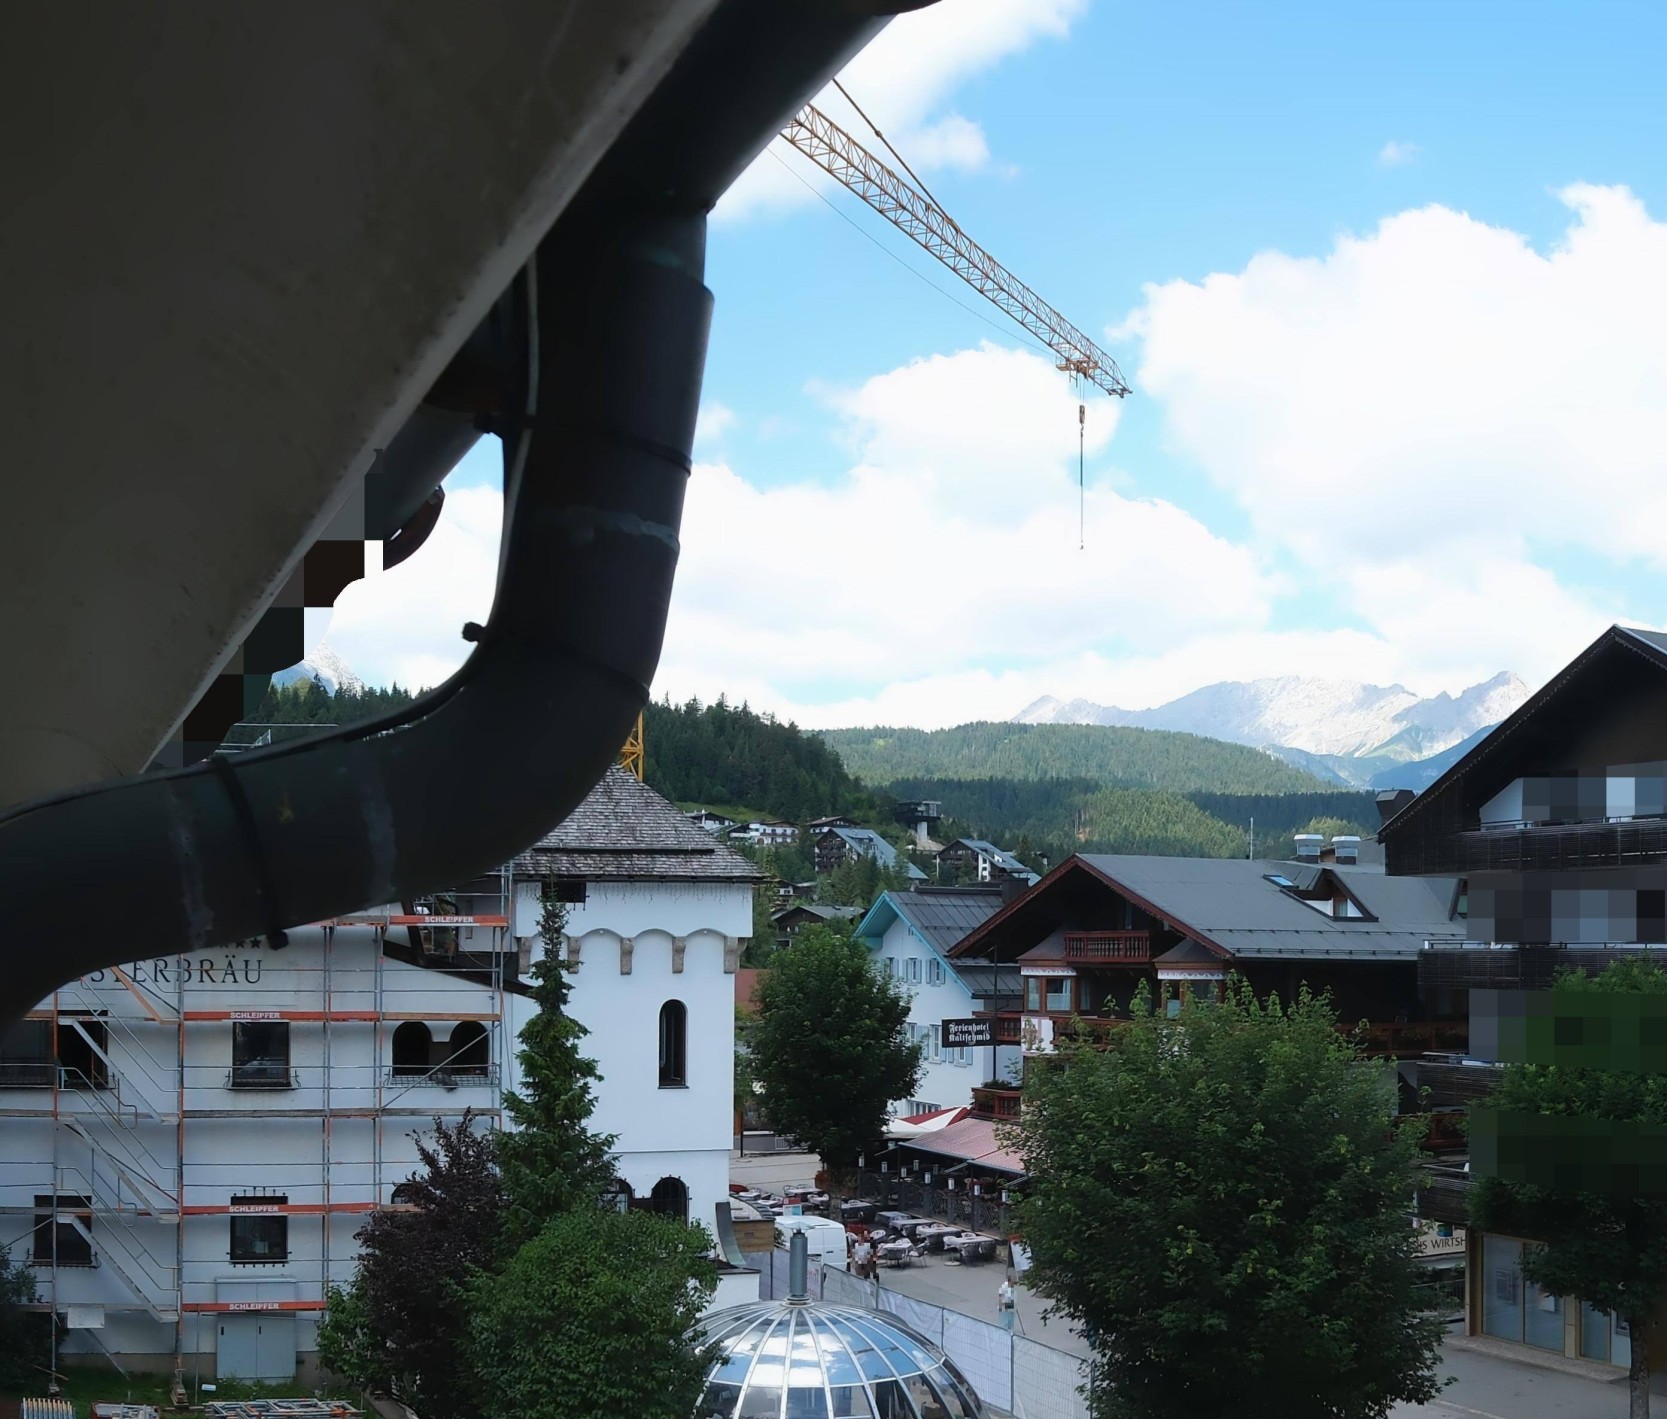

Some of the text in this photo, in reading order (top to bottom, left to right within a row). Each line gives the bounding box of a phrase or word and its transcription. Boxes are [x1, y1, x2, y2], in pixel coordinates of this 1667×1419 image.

[424, 916, 474, 924] SCHLEIPFER
[72, 954, 262, 984] STERBRÄU
[230, 1011, 281, 1019] SCHLEIPFER
[229, 1204, 279, 1213] SCHLEIPFER
[229, 1302, 279, 1310] SCHLEIPFER
